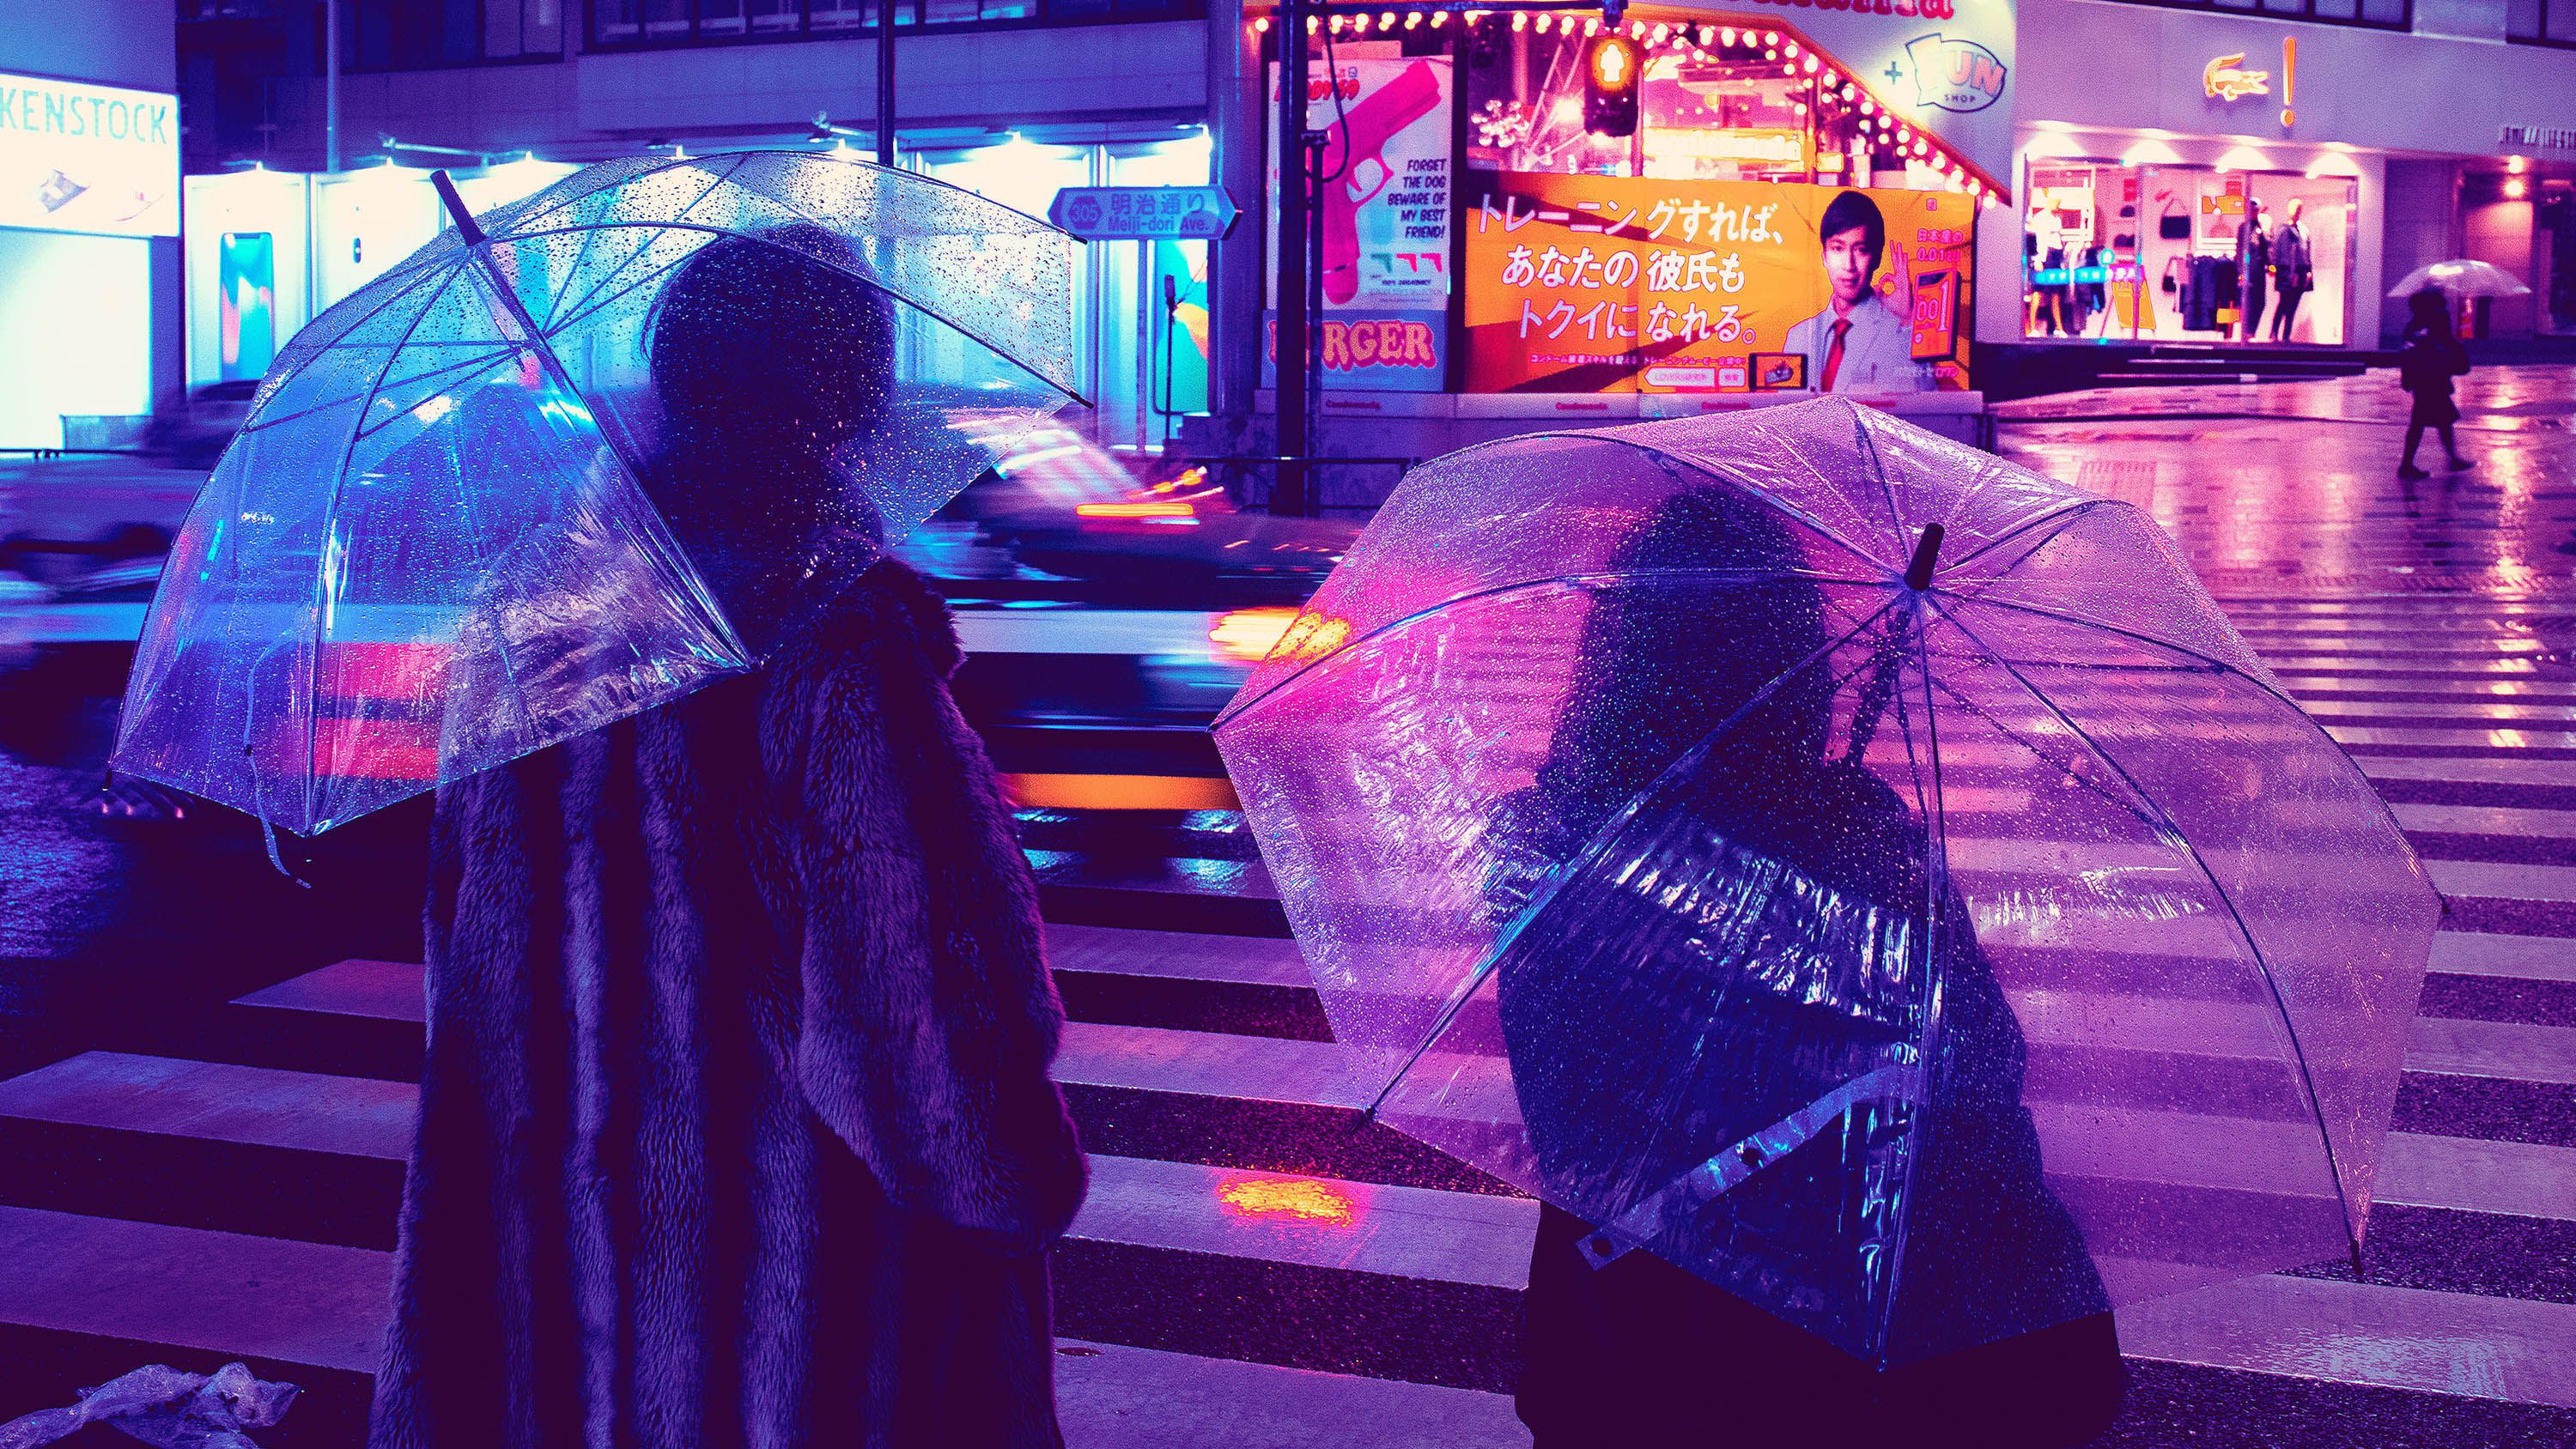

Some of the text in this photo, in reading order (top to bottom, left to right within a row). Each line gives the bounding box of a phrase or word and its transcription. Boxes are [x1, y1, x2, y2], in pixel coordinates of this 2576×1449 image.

[0, 88, 167, 144] KENSTOCK
[1407, 158, 1446, 172] FORGET
[1403, 175, 1447, 189] THE DOG
[1111, 193, 1205, 215] 明治通り
[1388, 192, 1446, 206] BEWARE OF
[1072, 205, 1101, 222] 305
[1401, 209, 1446, 222] MY BEST
[1479, 193, 1784, 246] トレーニングすれば、
[1109, 216, 1210, 233] Meiji-dori Ave.
[1405, 226, 1446, 239] FRIEND!
[1501, 244, 1746, 294] あなたの彼氏も
[1519, 299, 1757, 345] トクイになれる。
